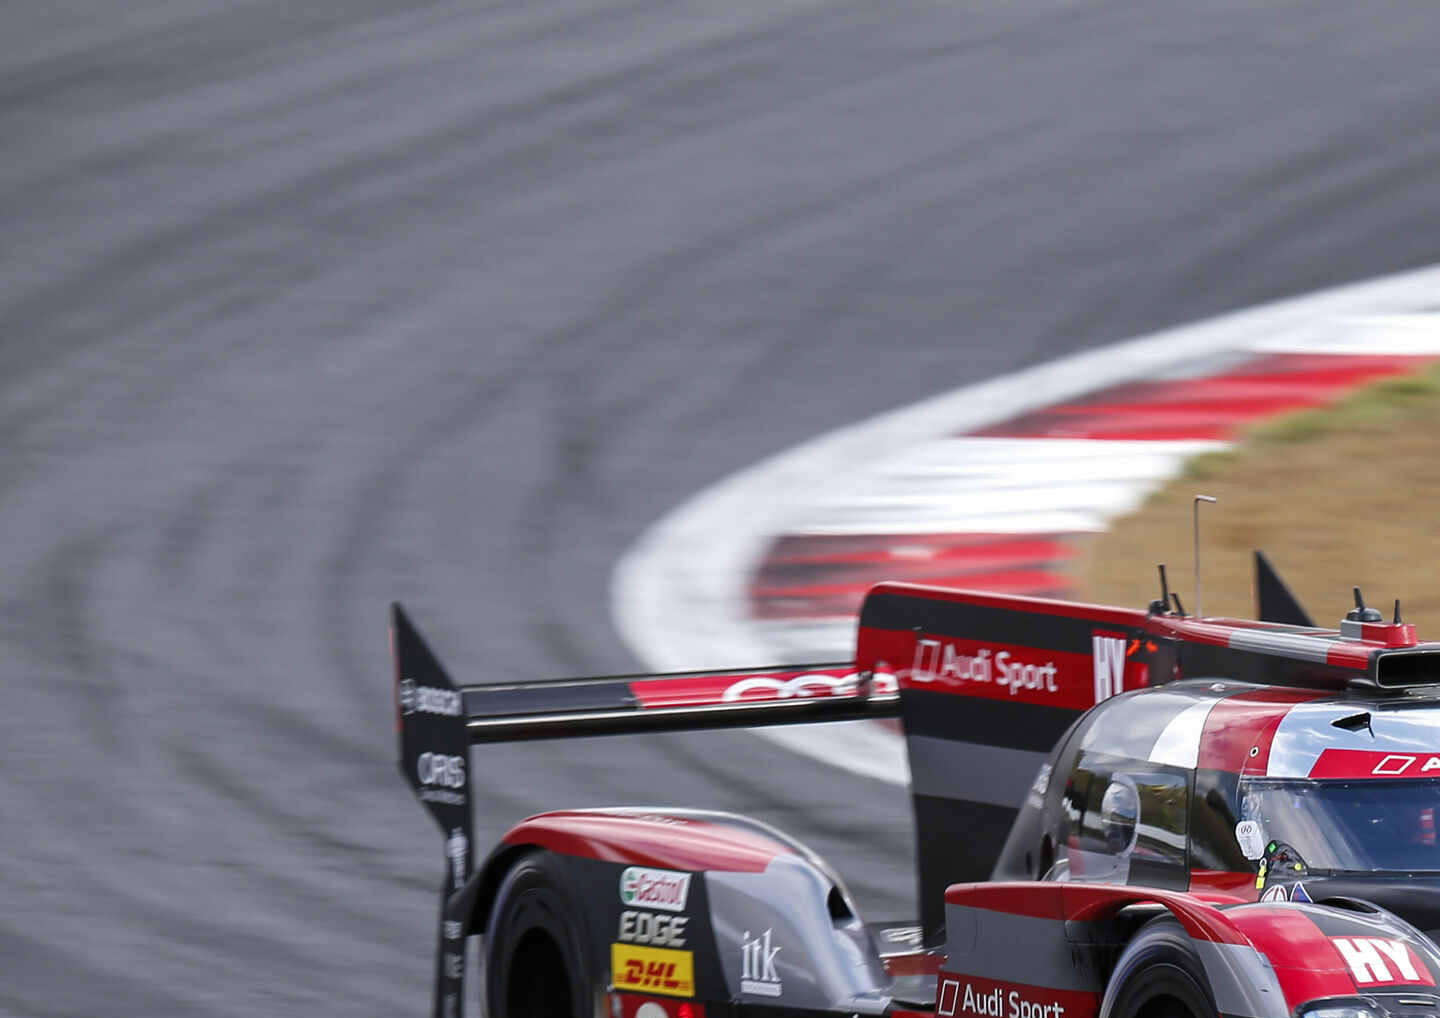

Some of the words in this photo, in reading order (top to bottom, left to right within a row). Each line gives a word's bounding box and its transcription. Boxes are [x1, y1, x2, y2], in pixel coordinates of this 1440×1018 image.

[941, 644, 990, 682] Audi
[995, 652, 1058, 695] Sport
[1092, 636, 1126, 704] HY
[619, 911, 690, 947] EDGE
[625, 959, 678, 989] DHL
[741, 927, 782, 982] itk
[1332, 938, 1420, 983] HY
[962, 983, 1003, 1018] Audi
